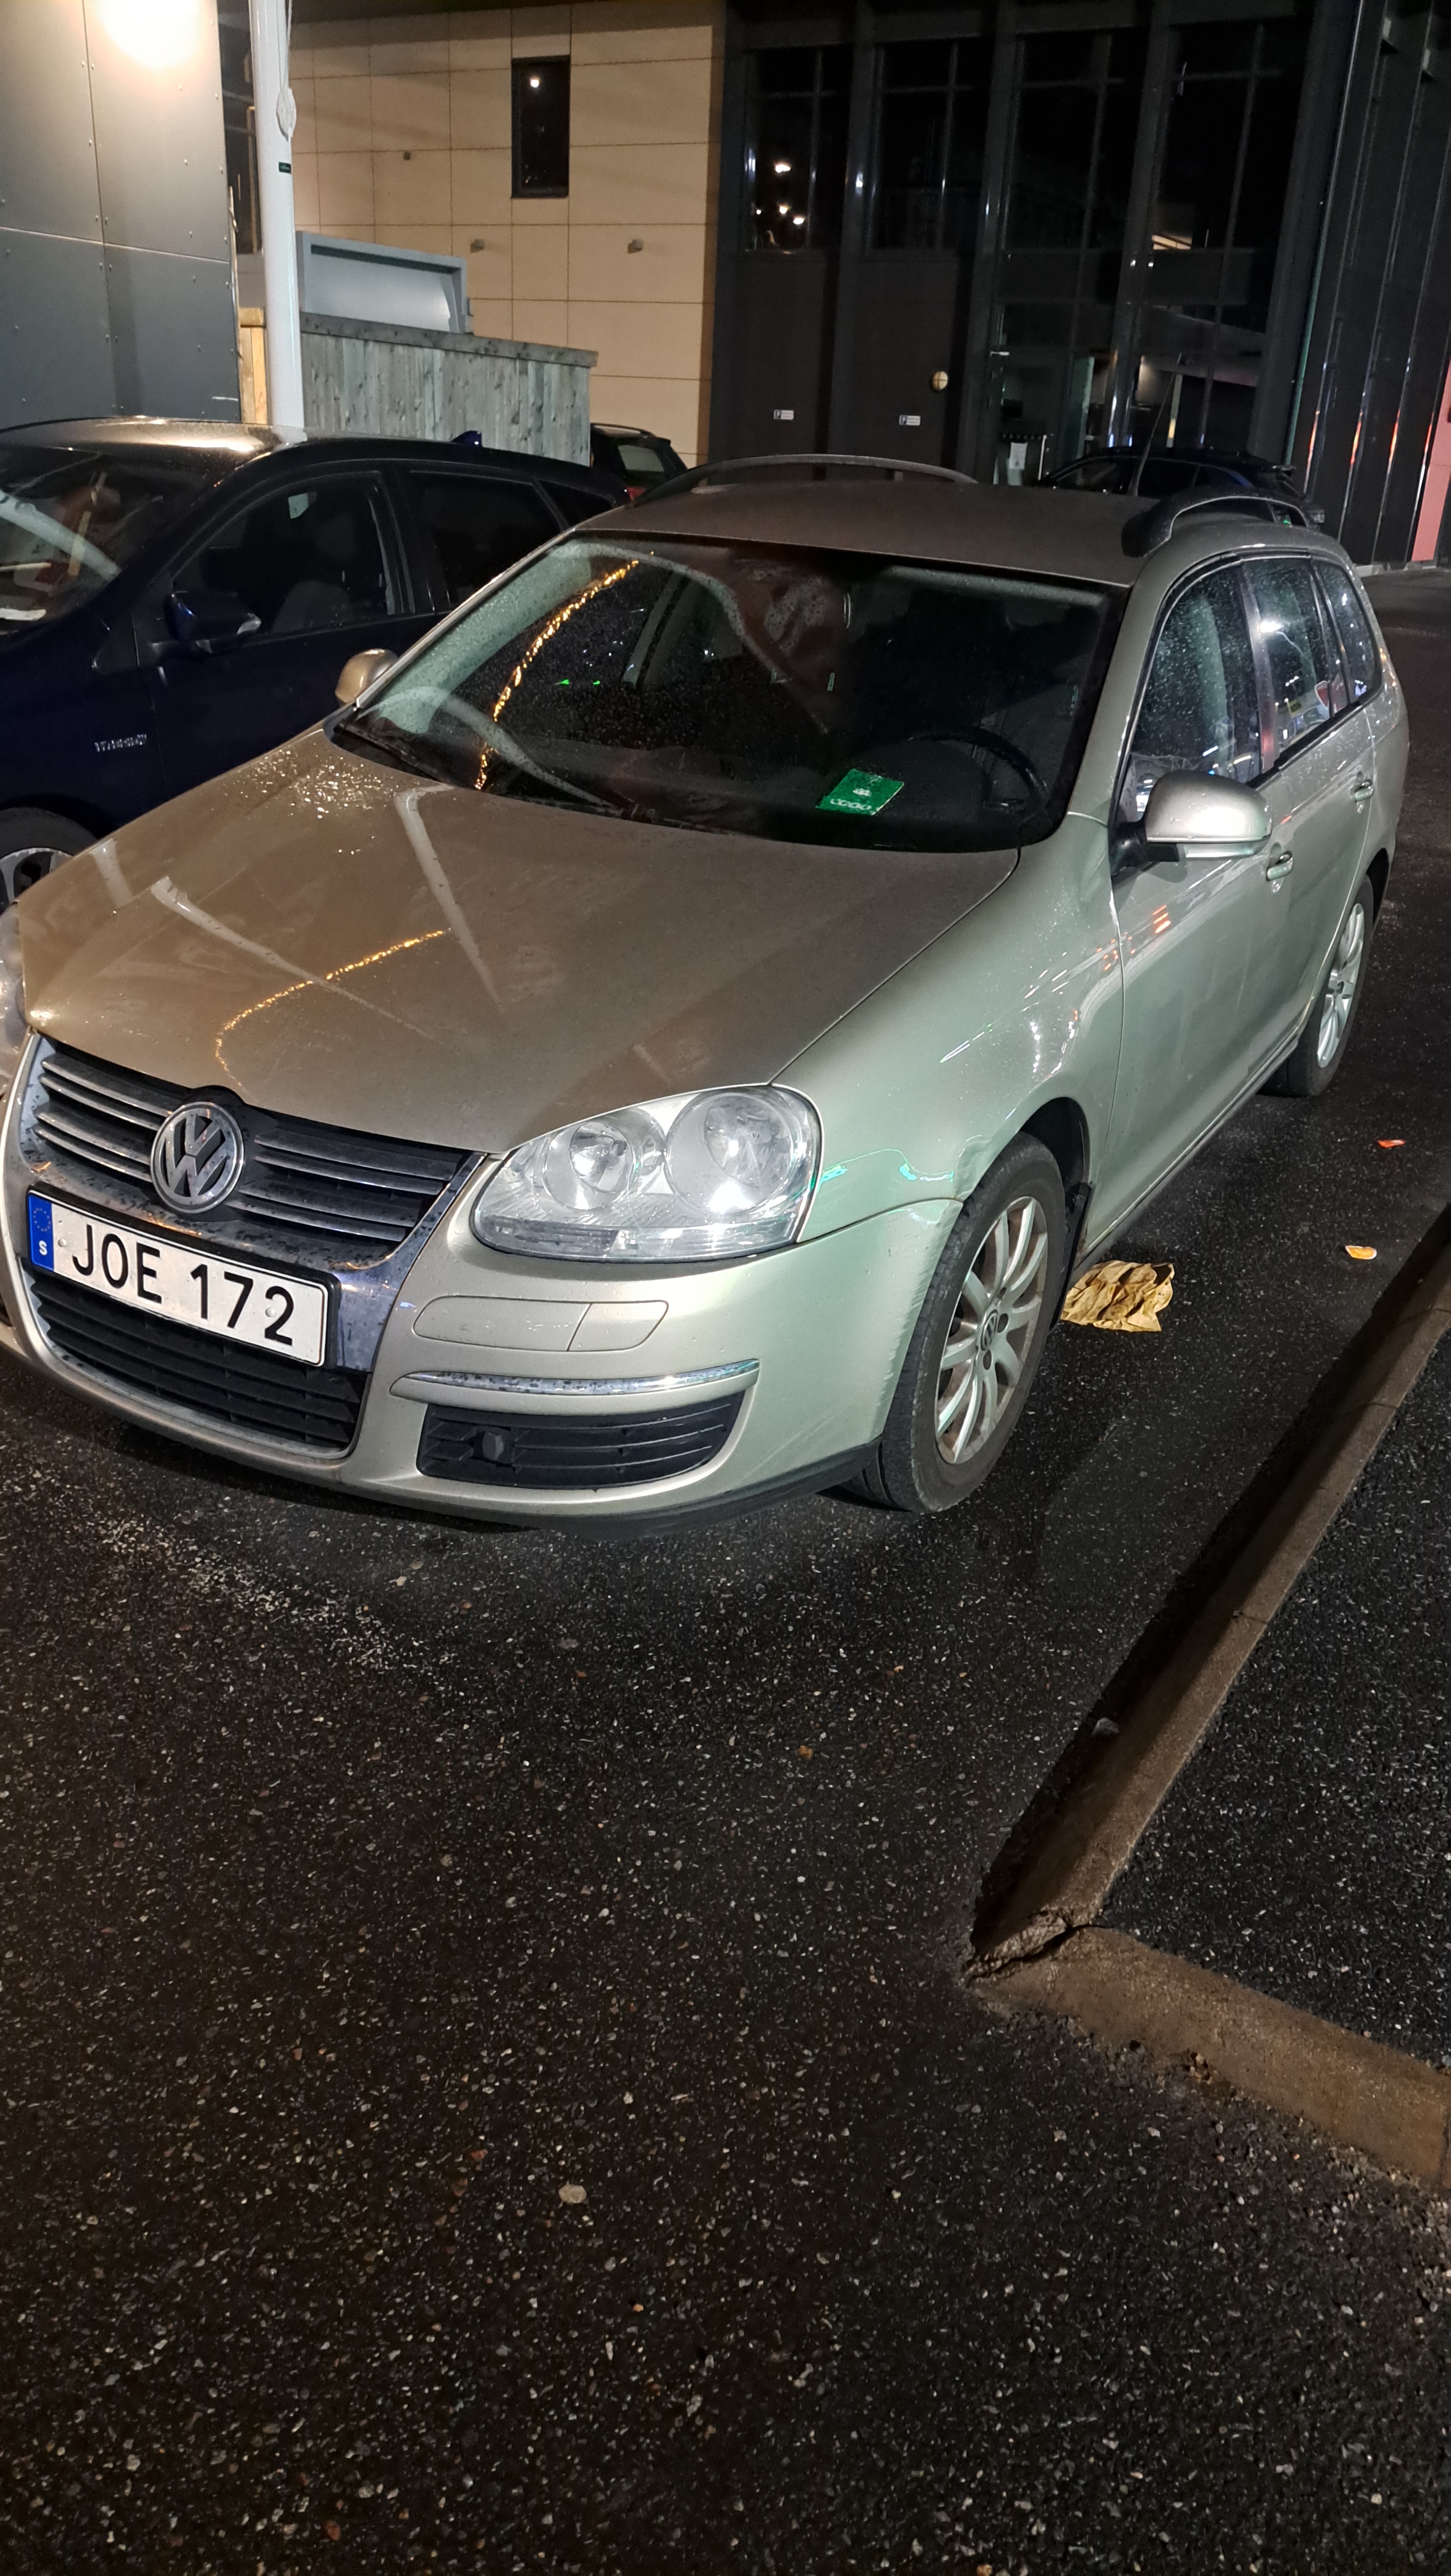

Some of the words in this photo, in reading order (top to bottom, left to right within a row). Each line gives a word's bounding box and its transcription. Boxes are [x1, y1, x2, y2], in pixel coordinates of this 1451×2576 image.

[154, 1106, 238, 1206] VW
[38, 1240, 47, 1256] S
[72, 1224, 162, 1304] JOE
[190, 1263, 294, 1346] 172
